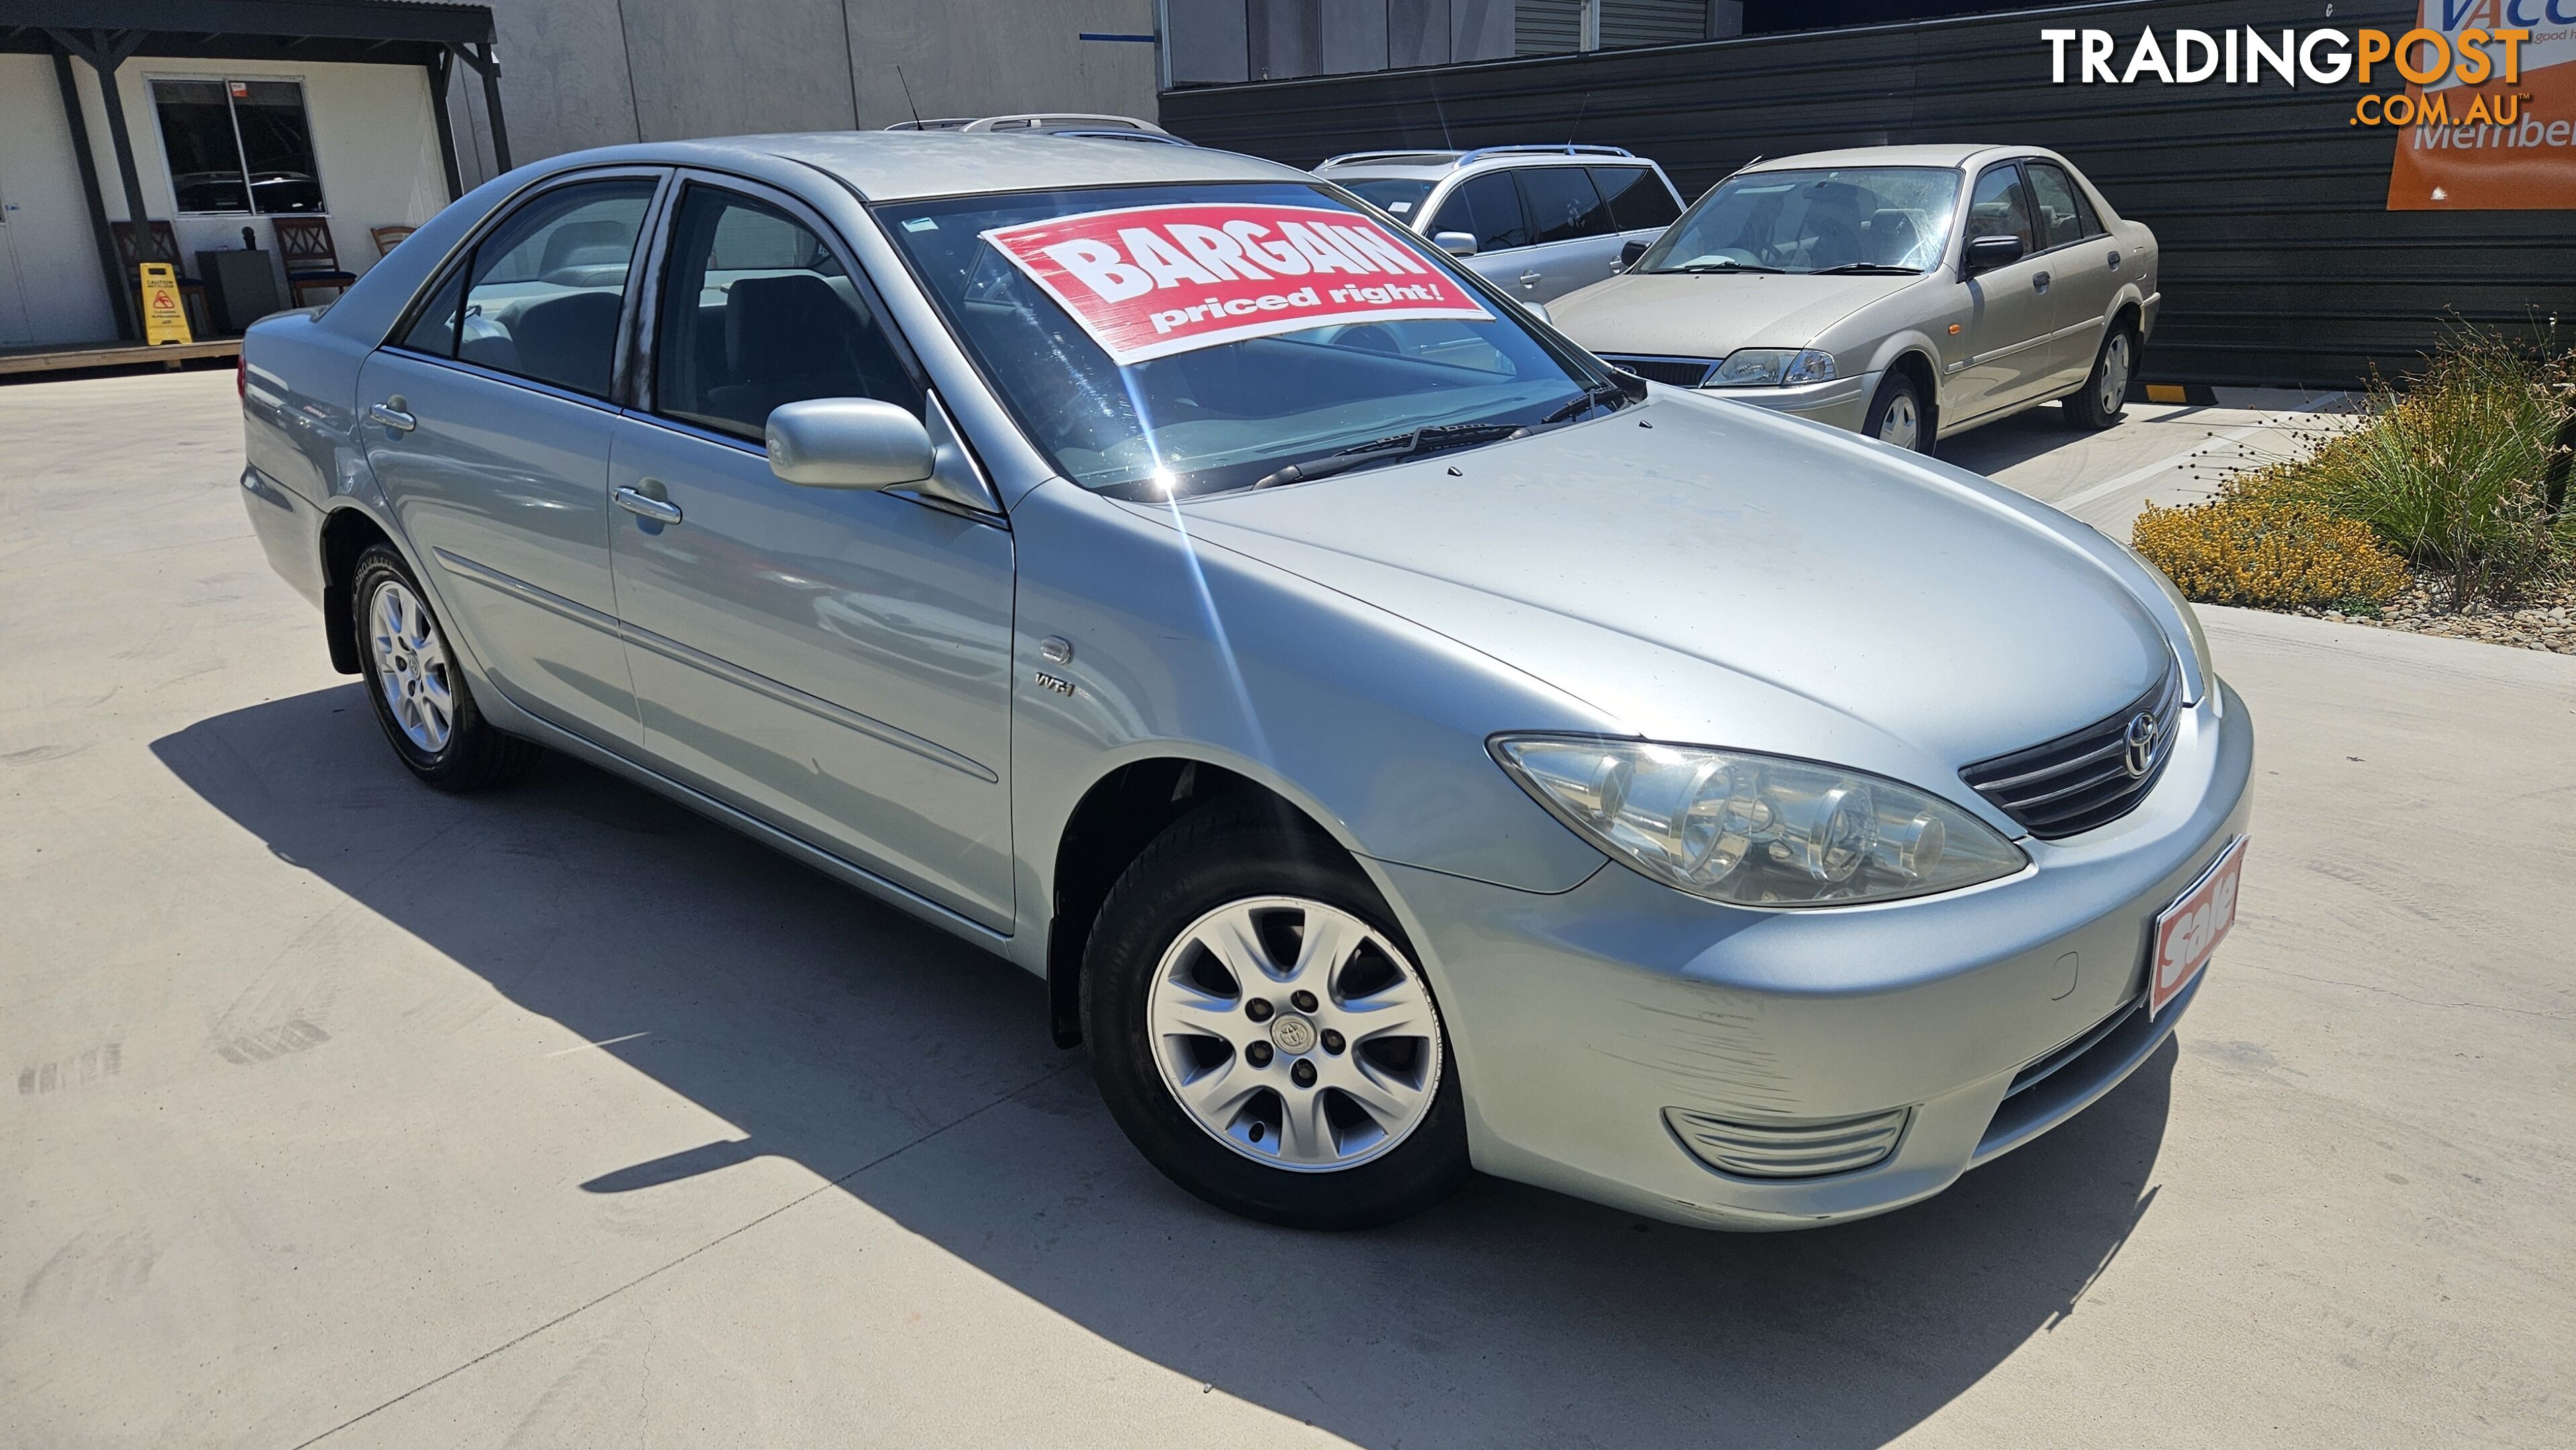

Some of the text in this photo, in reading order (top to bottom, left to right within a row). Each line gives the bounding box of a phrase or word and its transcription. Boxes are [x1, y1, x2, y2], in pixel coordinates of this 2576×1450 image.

[2534, 29, 2567, 45] good
[1042, 220, 1428, 304] BARGAIN
[1149, 283, 1445, 334] priced right!
